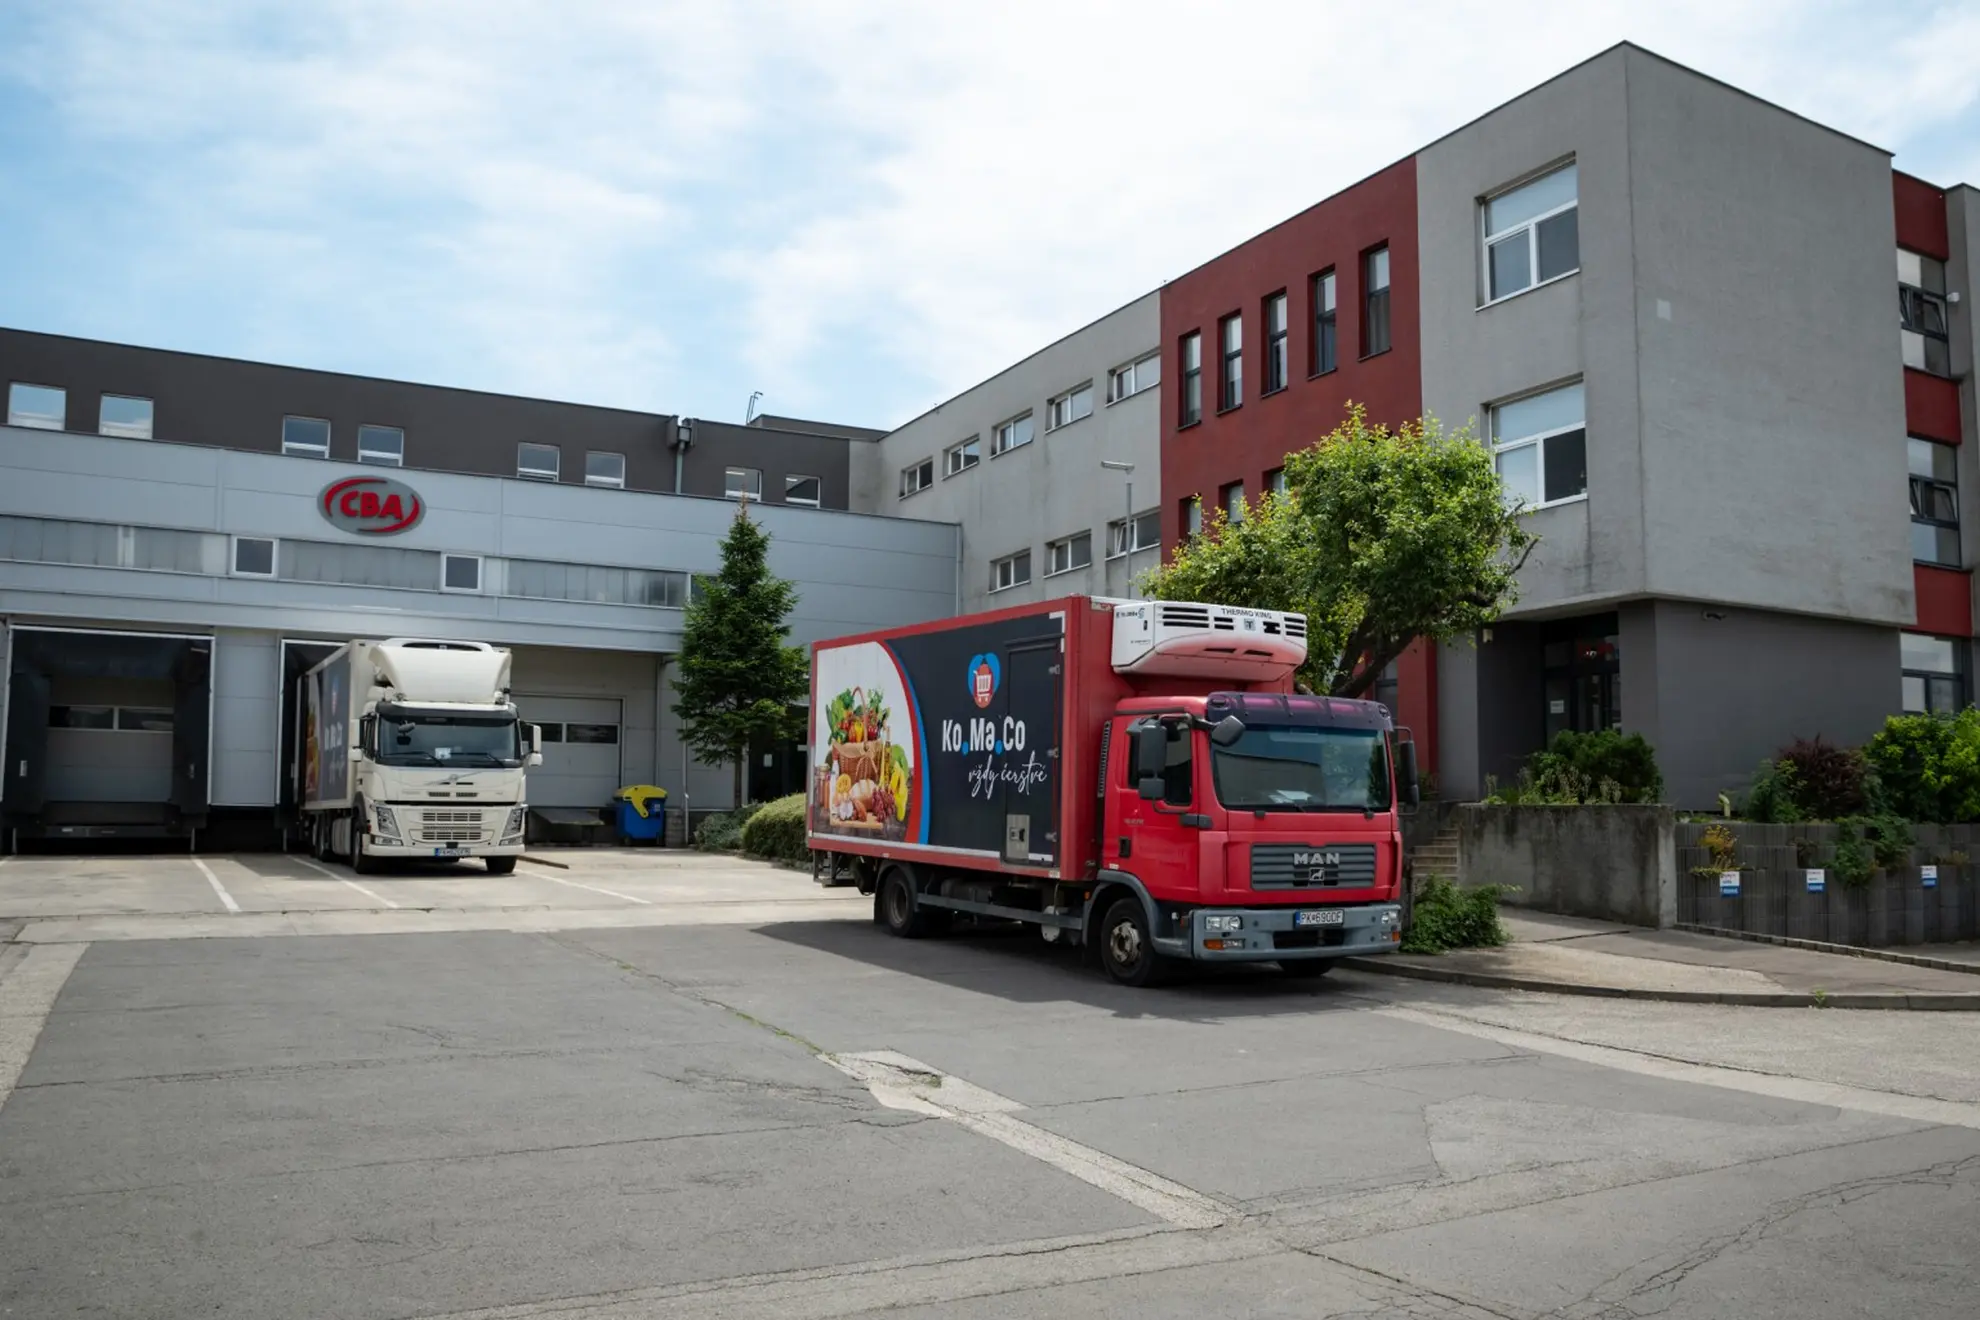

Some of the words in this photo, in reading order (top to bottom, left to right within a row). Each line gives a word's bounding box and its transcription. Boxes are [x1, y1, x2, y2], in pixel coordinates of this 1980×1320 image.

[340, 490, 404, 520] CBA
[1221, 607, 1254, 617] THERMO
[1255, 610, 1273, 619] KING
[1294, 852, 1339, 865] MAN
